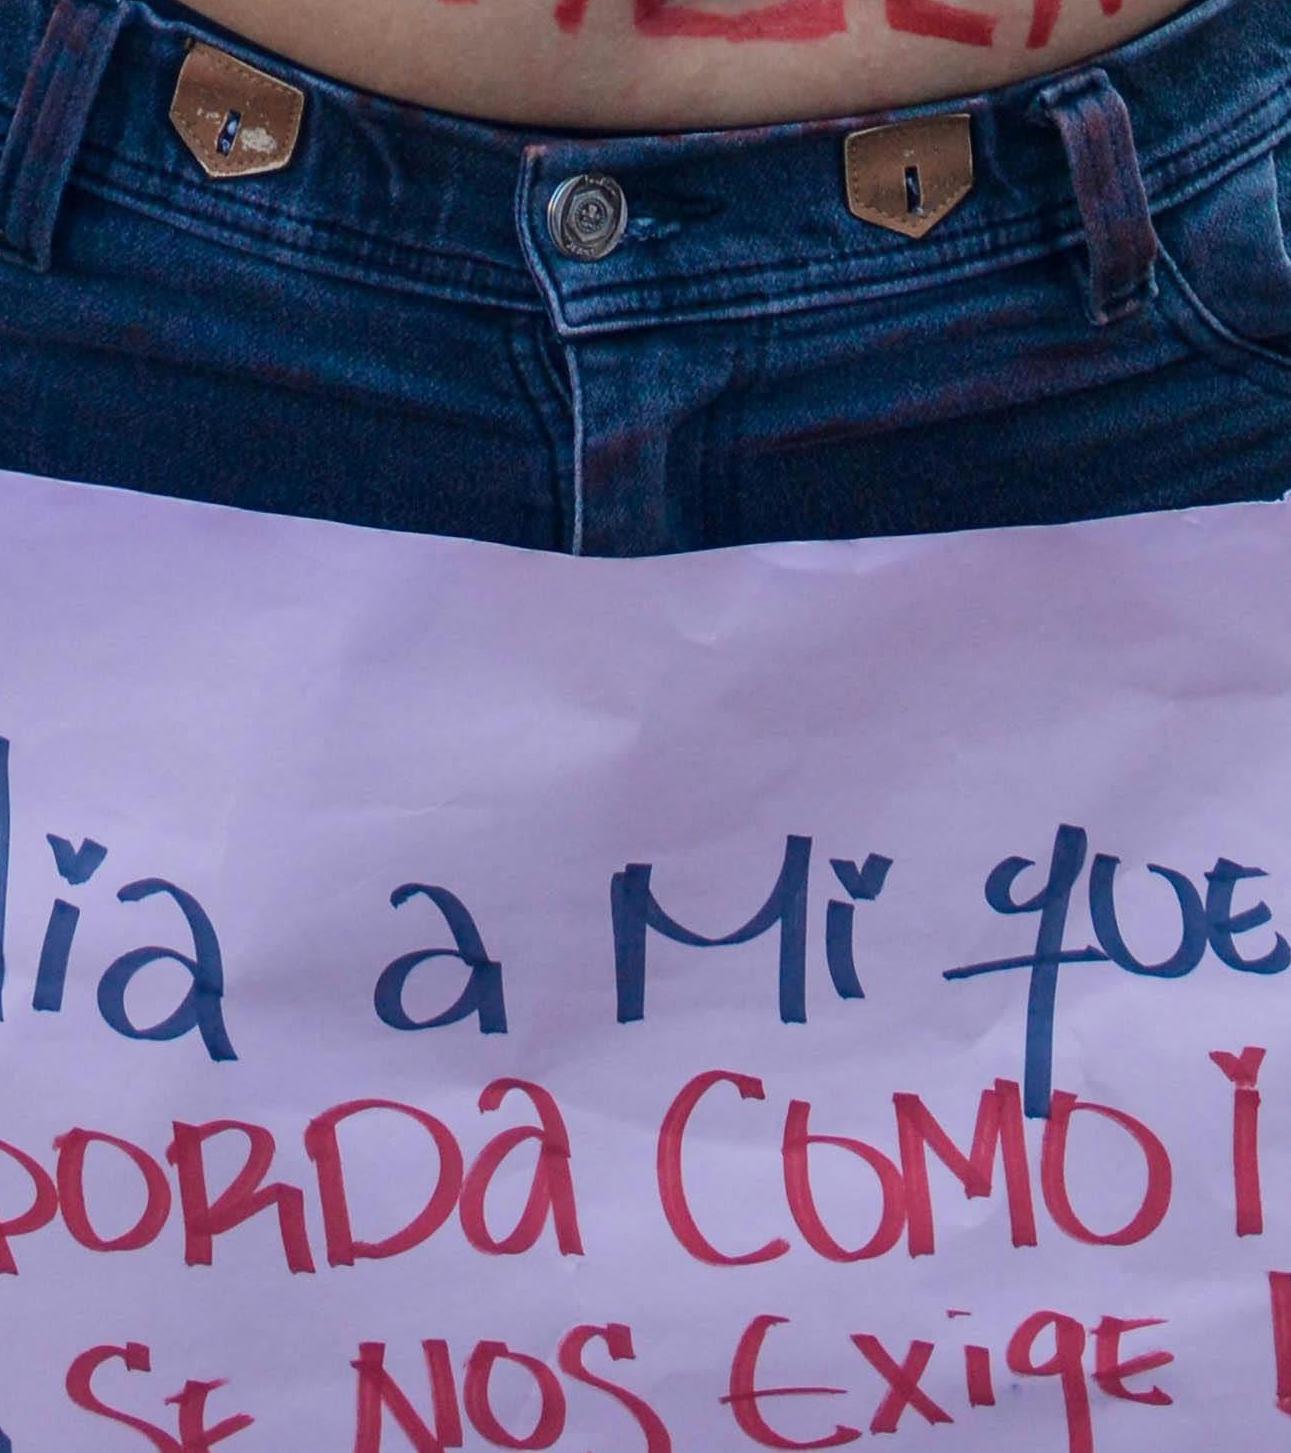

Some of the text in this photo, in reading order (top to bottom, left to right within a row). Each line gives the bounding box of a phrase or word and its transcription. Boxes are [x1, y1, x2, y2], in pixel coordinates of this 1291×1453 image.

[372, 883, 508, 1035] a
[656, 1071, 1173, 1268] COMO
[351, 1321, 673, 1453] NOS
